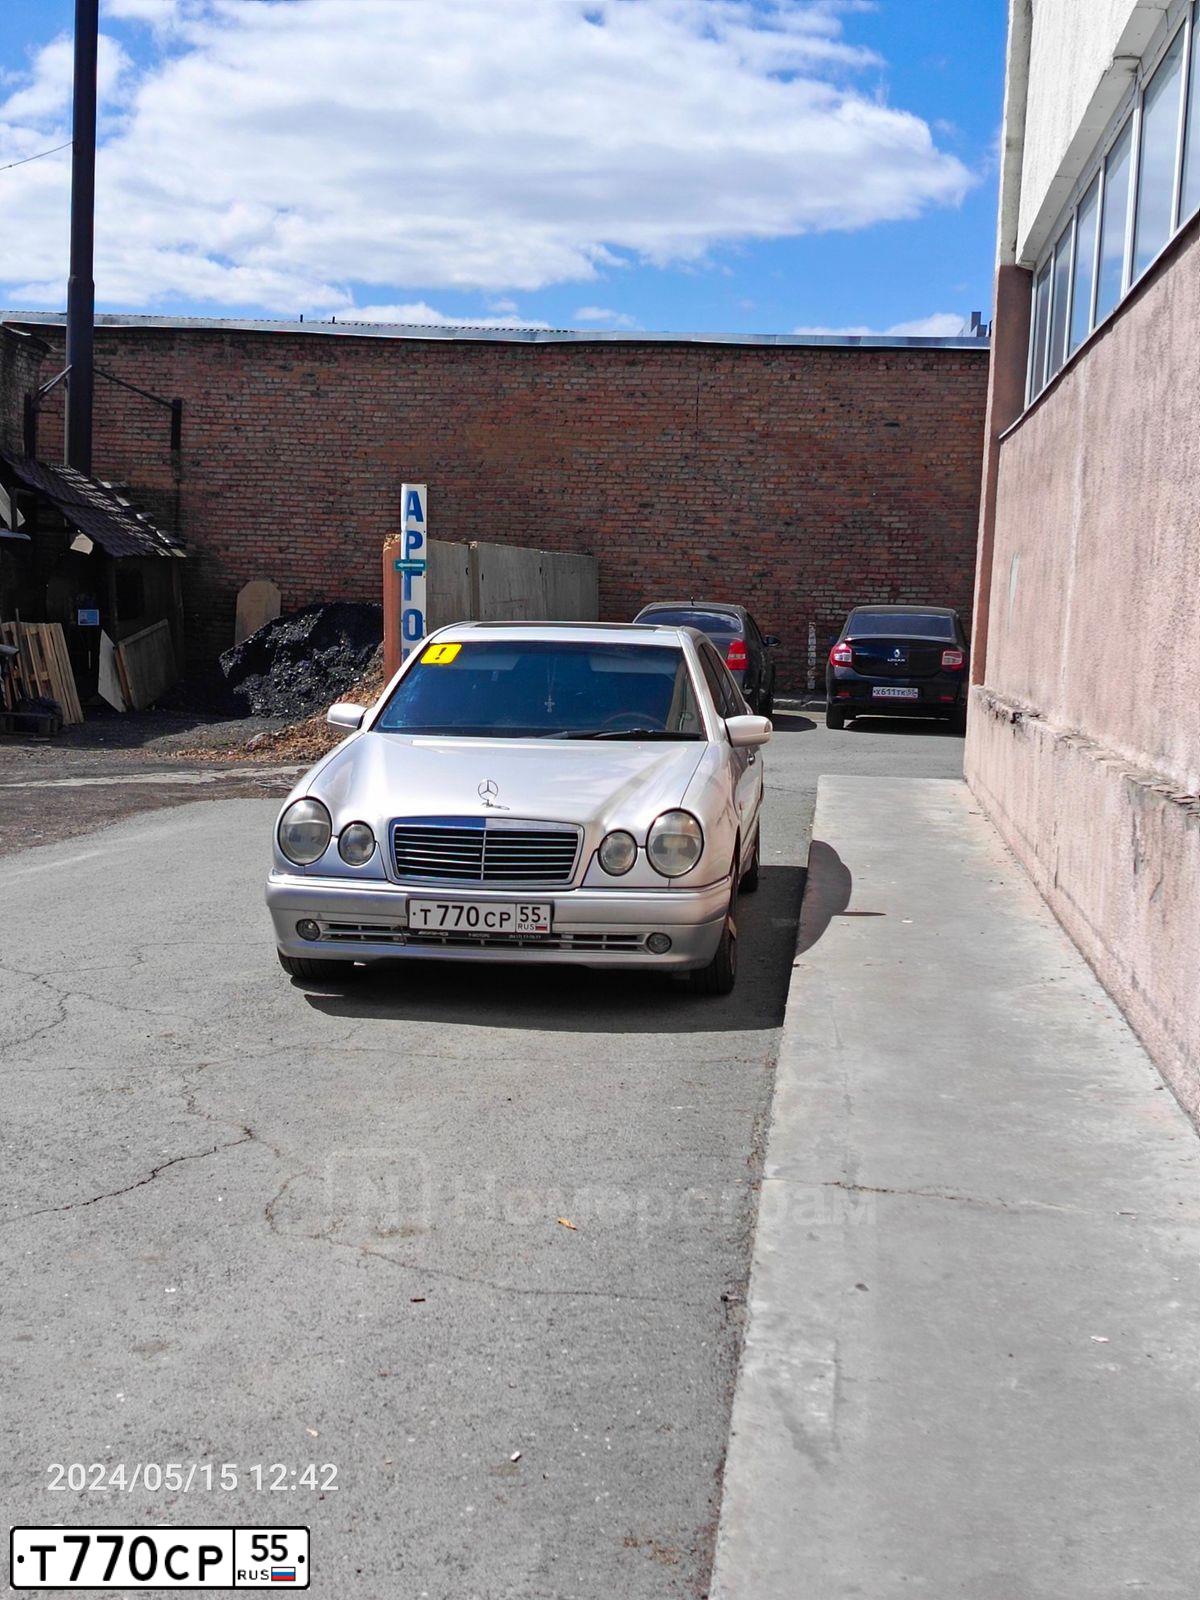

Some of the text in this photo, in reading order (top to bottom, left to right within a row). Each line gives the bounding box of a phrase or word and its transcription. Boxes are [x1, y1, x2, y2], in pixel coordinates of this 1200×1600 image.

[420, 904, 541, 928] Т770СР 55
[518, 923, 535, 931] RUS
